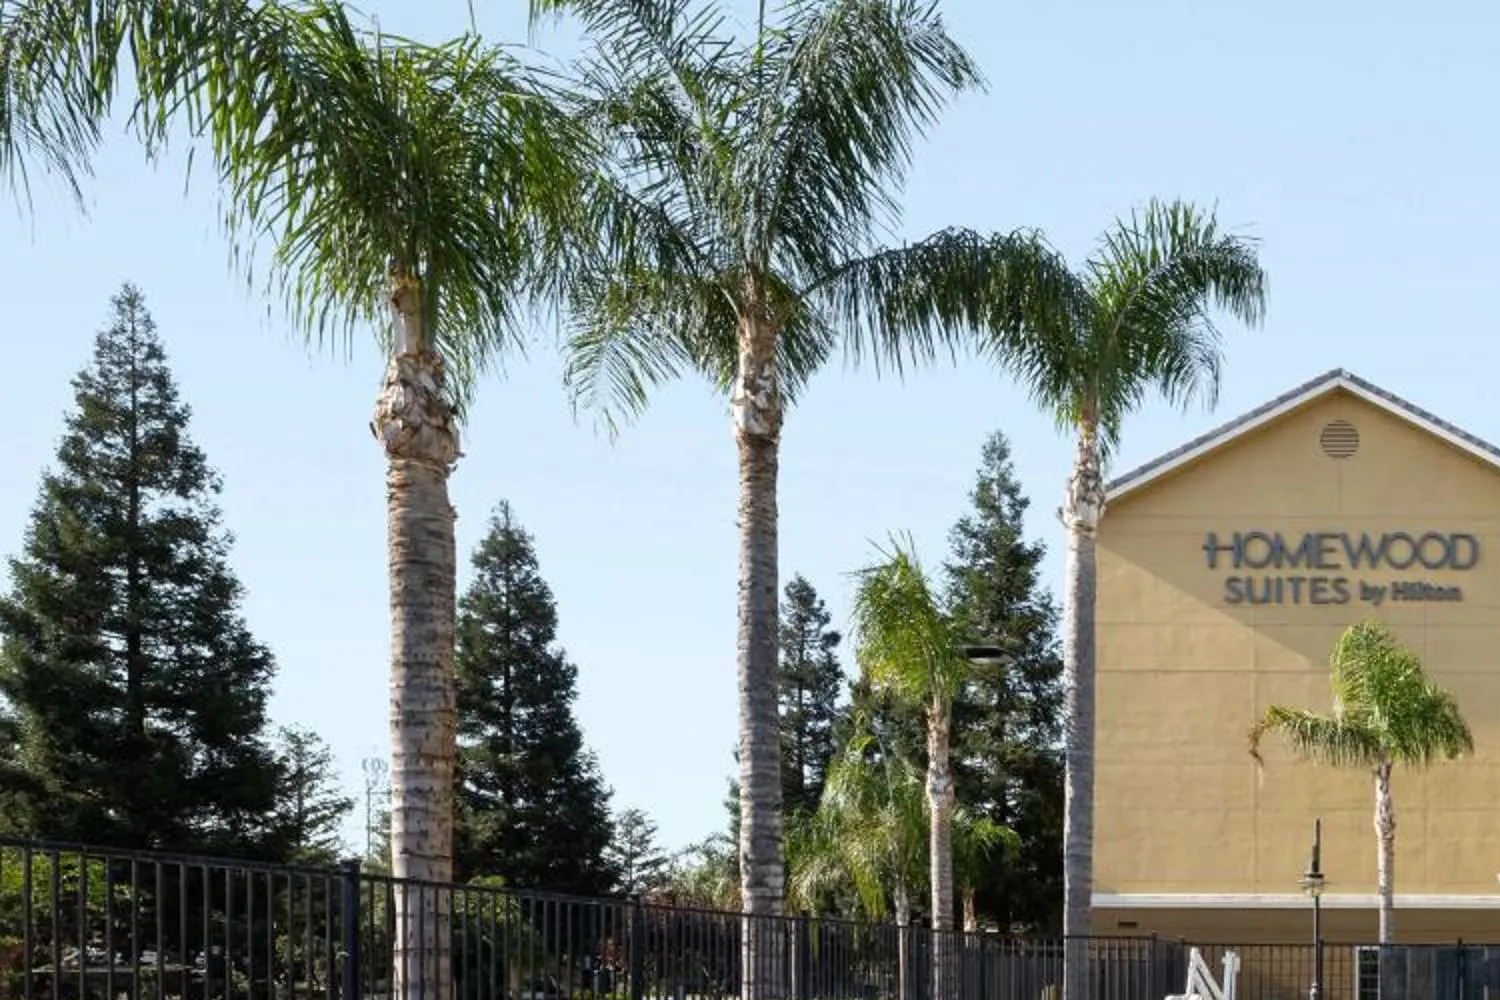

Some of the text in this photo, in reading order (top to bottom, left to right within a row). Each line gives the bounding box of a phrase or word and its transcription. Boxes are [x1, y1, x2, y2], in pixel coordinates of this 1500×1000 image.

[1202, 531, 1478, 570] HOMEWOOD
[1224, 576, 1350, 605] SUITES
[1360, 580, 1388, 606] by
